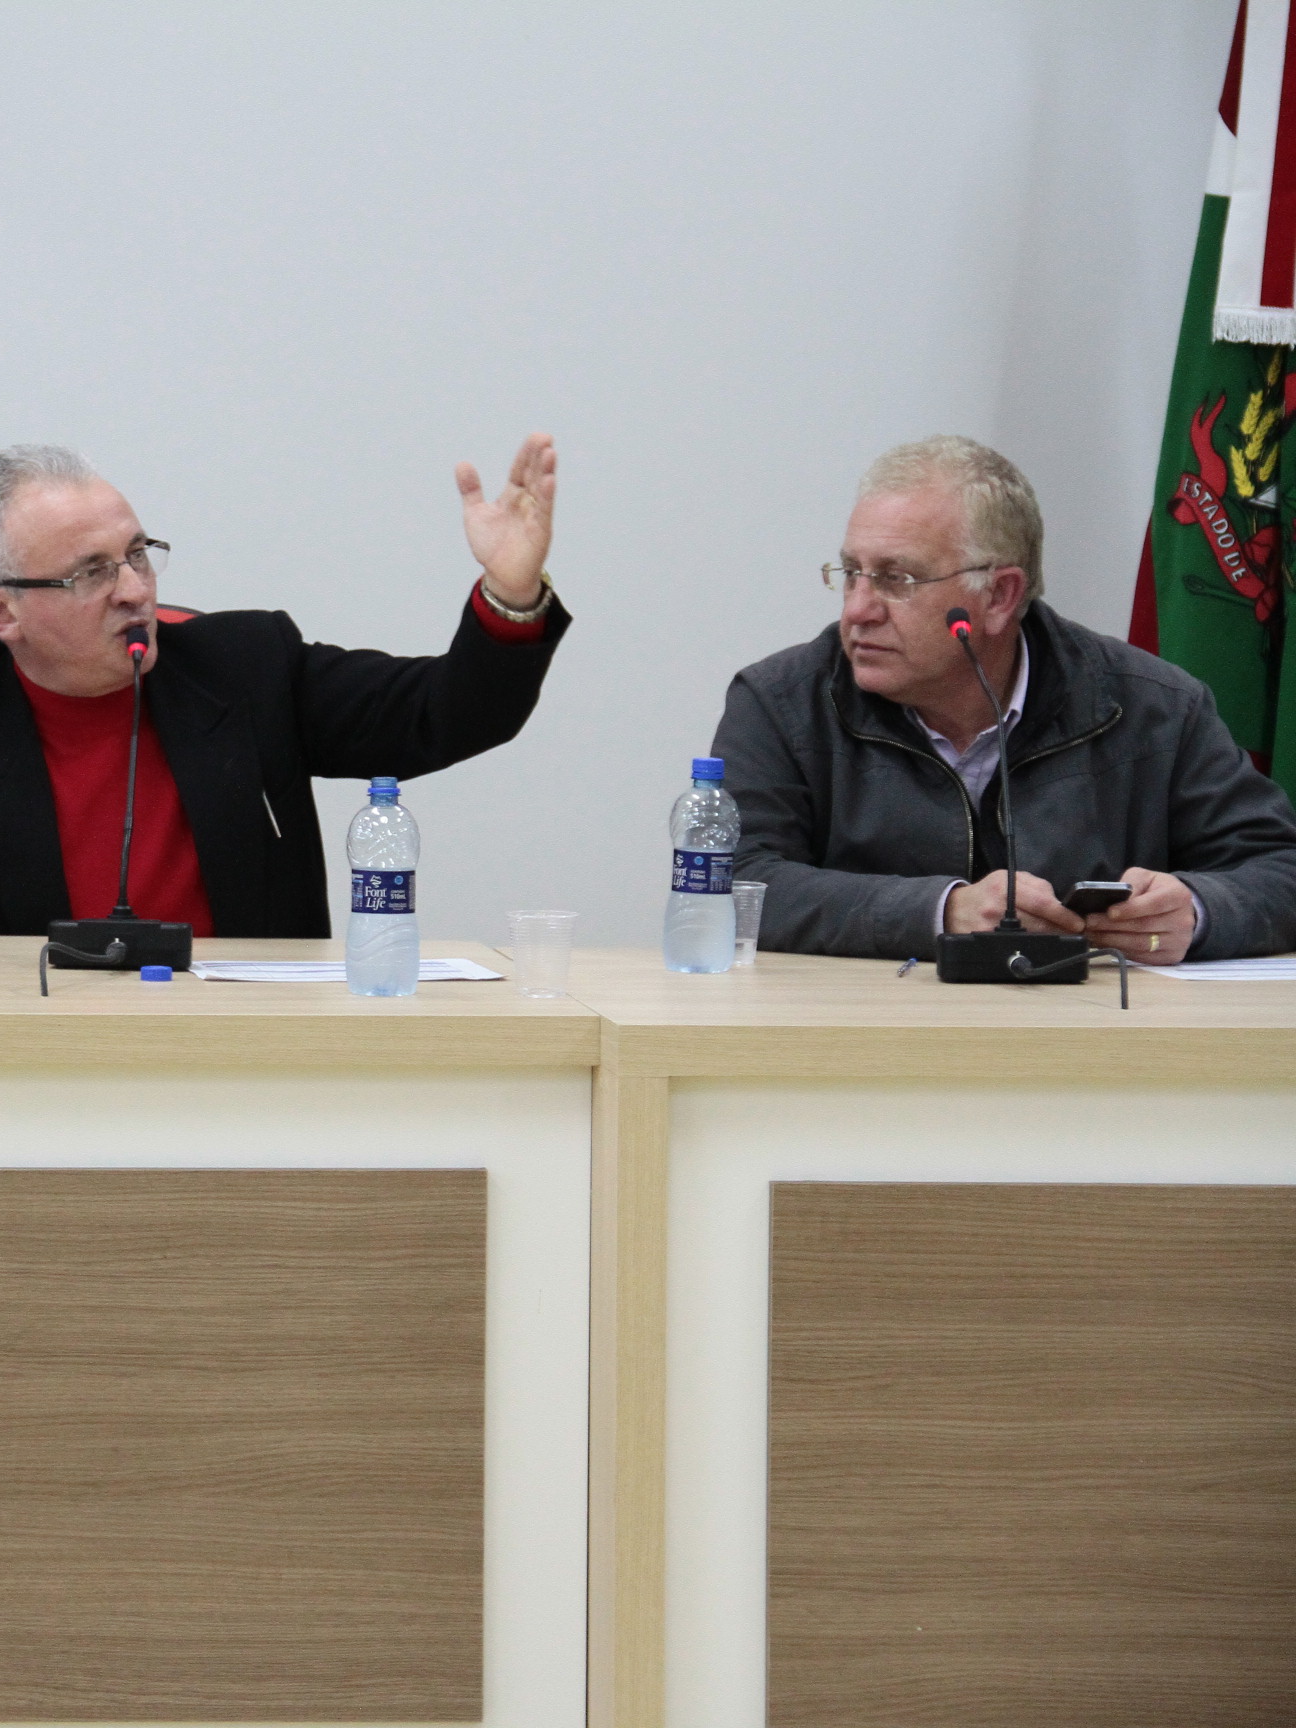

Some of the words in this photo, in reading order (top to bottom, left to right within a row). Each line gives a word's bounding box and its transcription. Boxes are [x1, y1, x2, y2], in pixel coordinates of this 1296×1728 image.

[1224, 551, 1246, 582] DE
[365, 886, 387, 897] Font
[366, 898, 386, 910] Life
